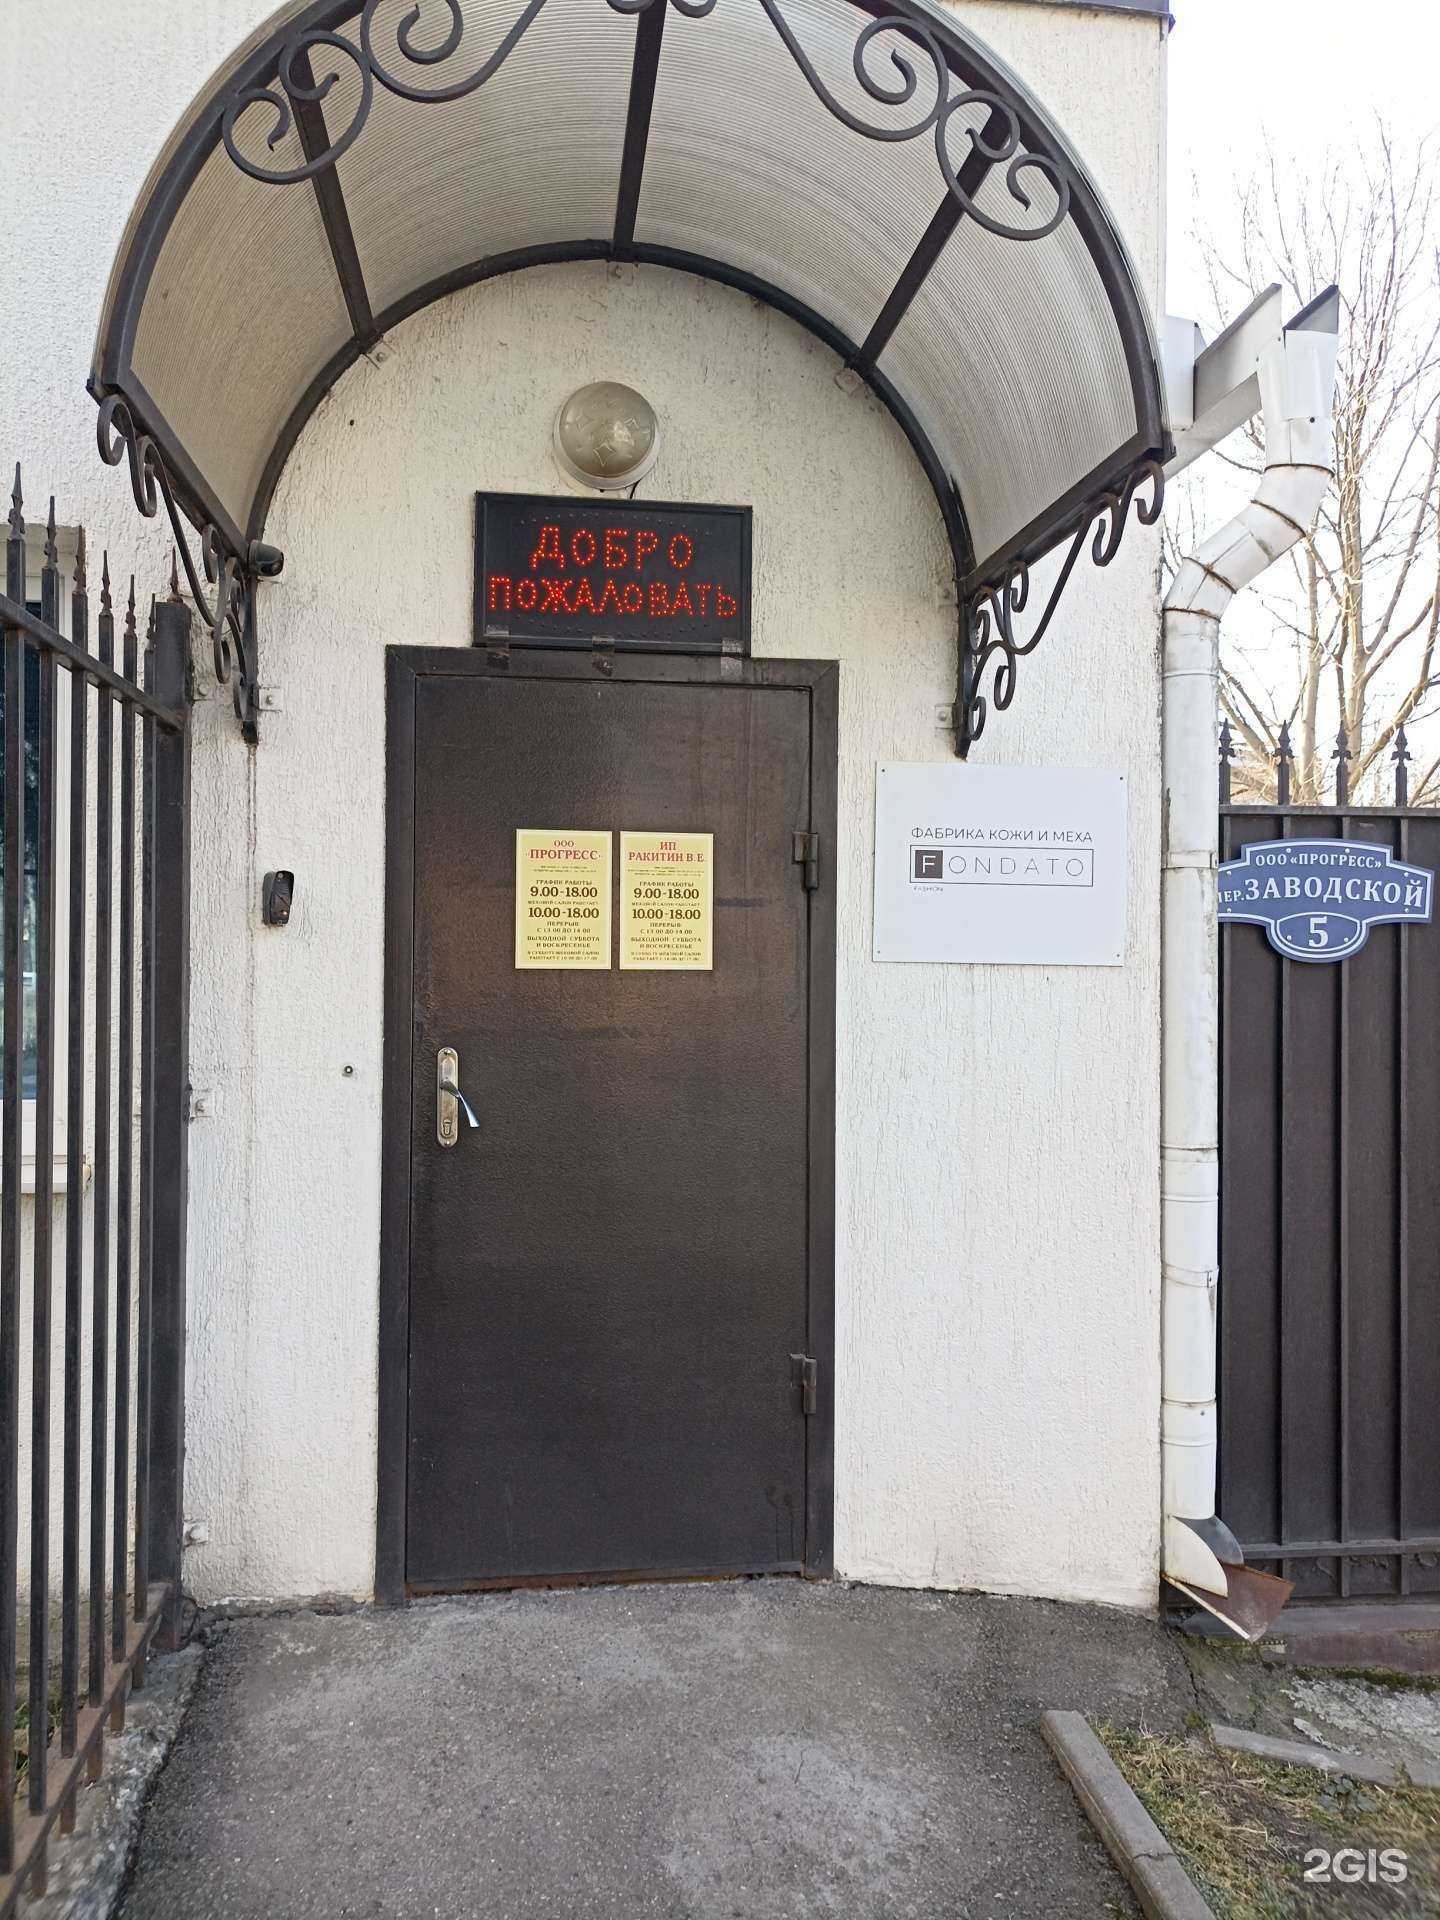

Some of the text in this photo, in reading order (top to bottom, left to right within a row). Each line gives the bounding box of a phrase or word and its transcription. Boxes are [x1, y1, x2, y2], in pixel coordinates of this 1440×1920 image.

[528, 524, 694, 570] ДОБРО
[489, 575, 738, 617] ПОЖАЛОВАТЬ
[553, 840, 575, 848] ООО
[911, 827, 1093, 843] ФАБРИКА КОЖИ И МЕХА
[660, 841, 677, 851] ИП
[628, 851, 683, 862] РАКИТИН
[922, 854, 1084, 877] FONDATO
[1255, 853, 1382, 868] ООО «ПРОГРЕСС»
[1244, 876, 1424, 908] ЗАВОДСКОЙ
[1308, 916, 1329, 948] 5
